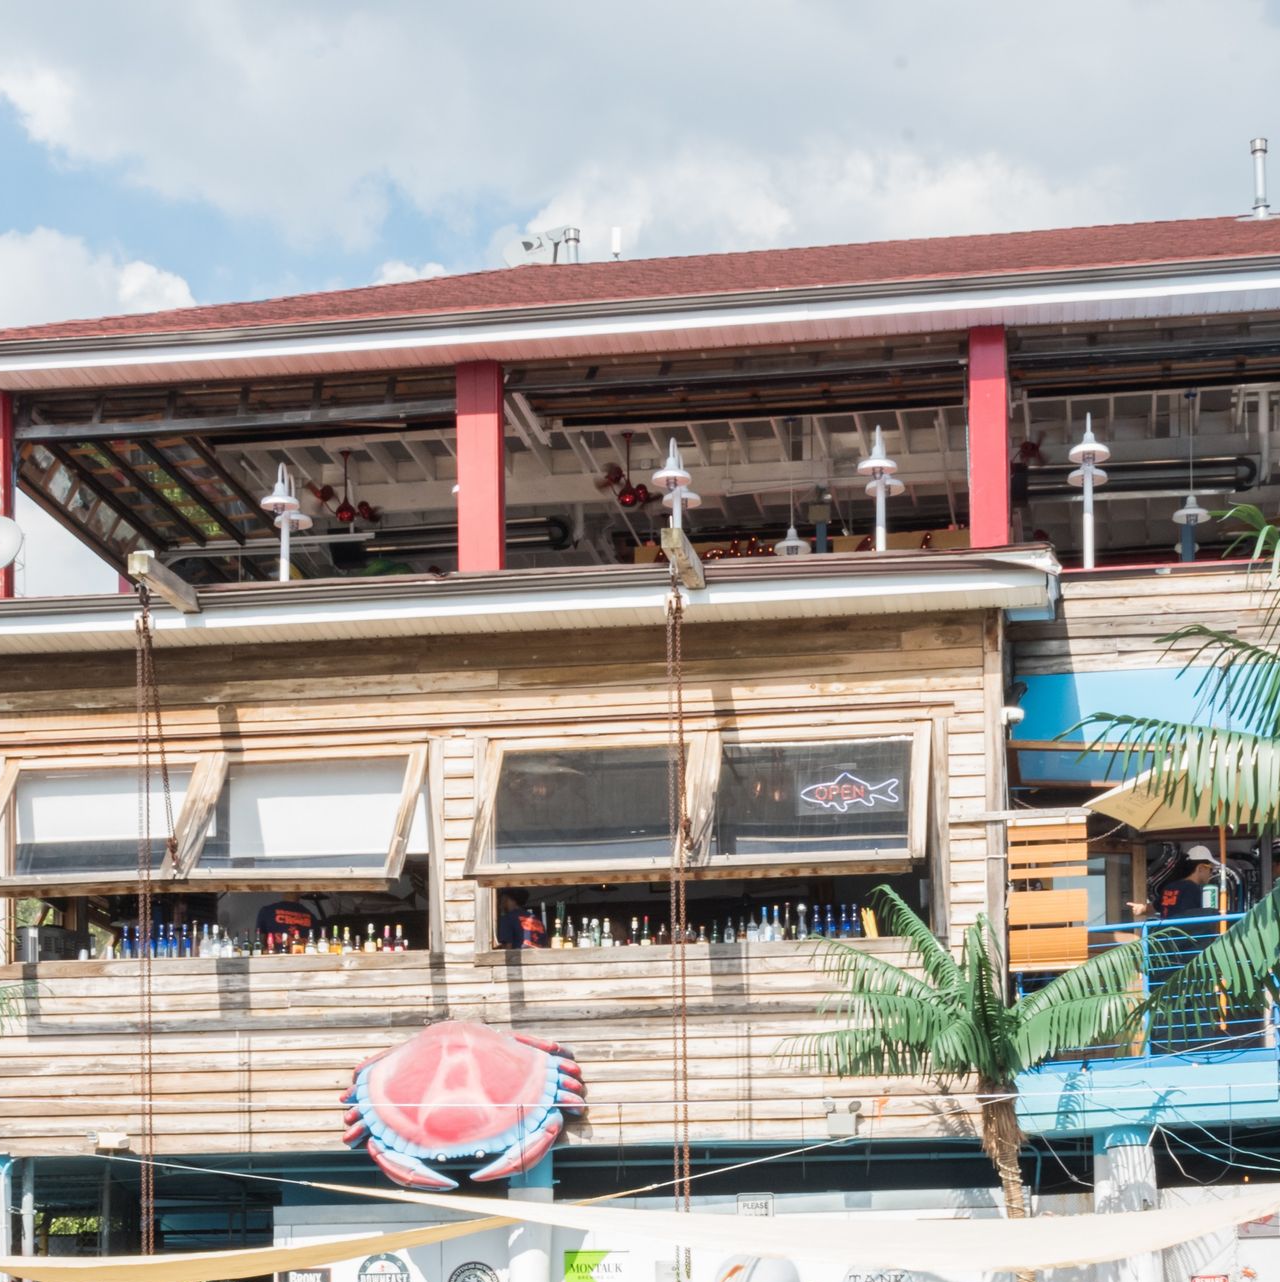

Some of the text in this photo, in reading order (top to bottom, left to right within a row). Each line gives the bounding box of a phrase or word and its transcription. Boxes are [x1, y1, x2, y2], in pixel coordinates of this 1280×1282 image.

[815, 784, 865, 801] OPEN
[742, 1201, 769, 1210] PLEASE
[570, 1263, 623, 1273] MONTAUK
